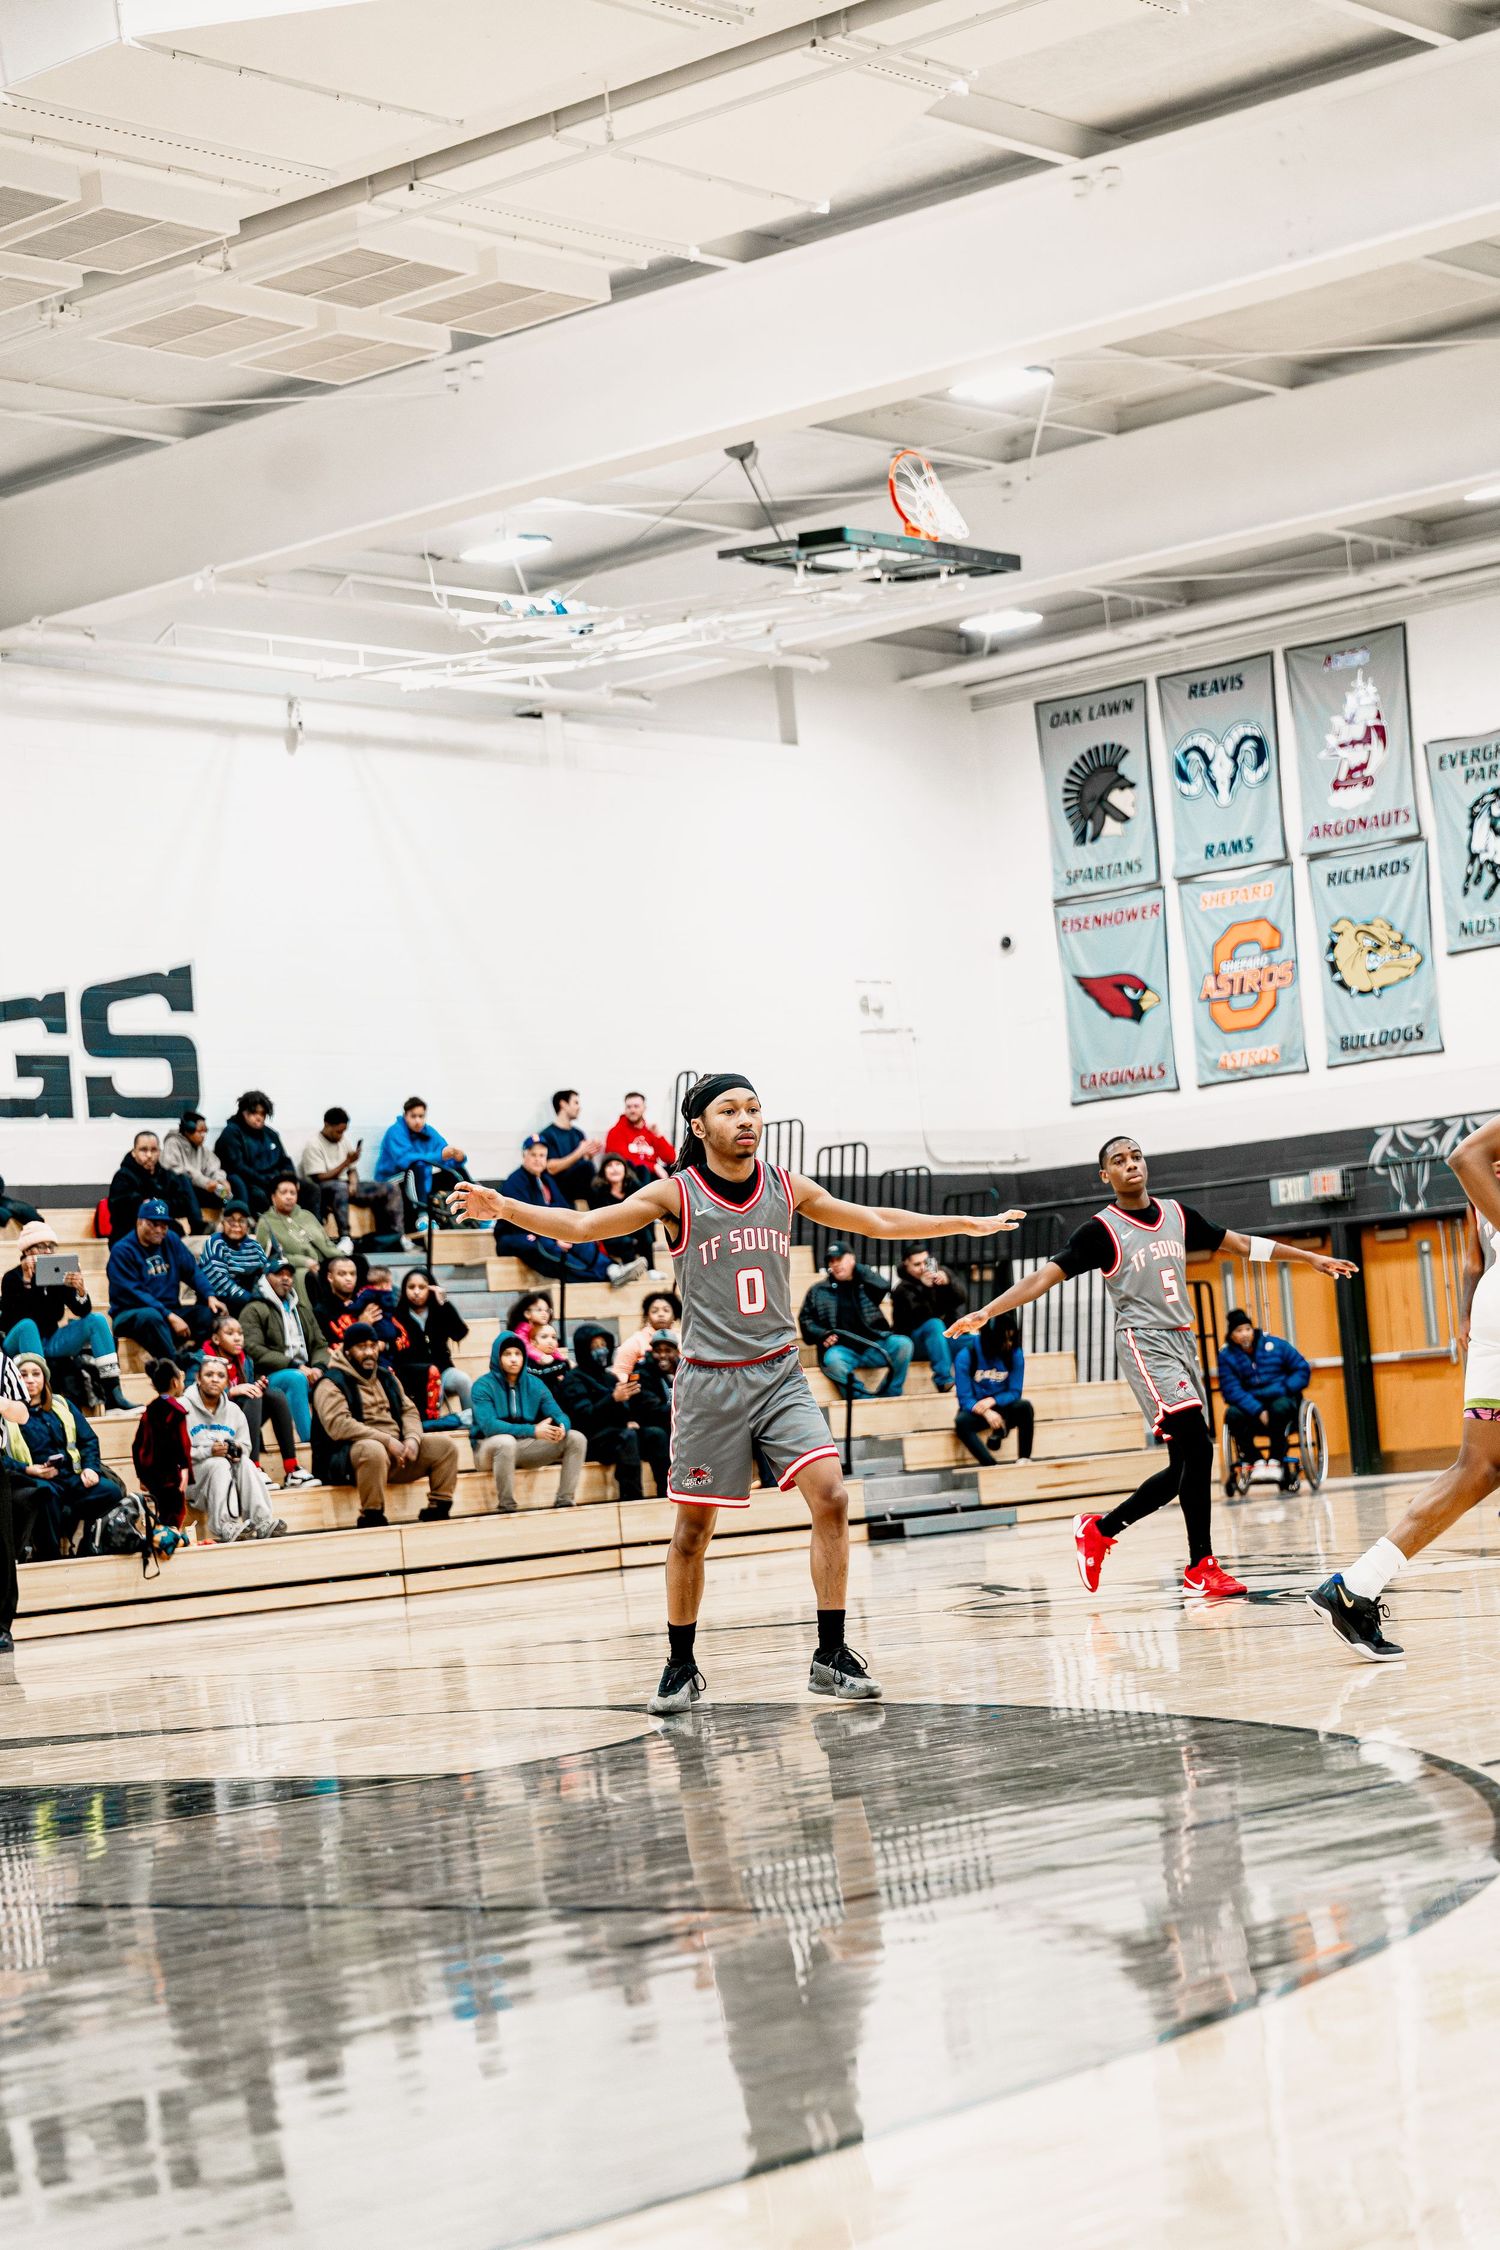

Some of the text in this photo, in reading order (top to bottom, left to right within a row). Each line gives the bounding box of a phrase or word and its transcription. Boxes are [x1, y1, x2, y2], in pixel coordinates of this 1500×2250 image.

[1188, 673, 1243, 700] REAVIS
[1050, 698, 1134, 728] OAK LAWN
[1307, 807, 1410, 840] ARGONAUTS
[1205, 835, 1254, 860] RAMS
[1065, 858, 1142, 886] SPARTANS
[1327, 857, 1410, 887] RICHARDS
[1201, 881, 1274, 911] SHEPARD
[1061, 903, 1160, 933] EISENHOWER
[1199, 960, 1294, 1001] ASTROS
[1340, 1023, 1424, 1051] BULLDOGS
[1217, 1046, 1281, 1070] ASTROS
[1080, 1062, 1166, 1089] CARDINALS
[698, 1226, 789, 1266] TF SOUTH
[1131, 1247, 1146, 1272] TF
[735, 1266, 767, 1316] 0
[1160, 1267, 1179, 1304] 5
